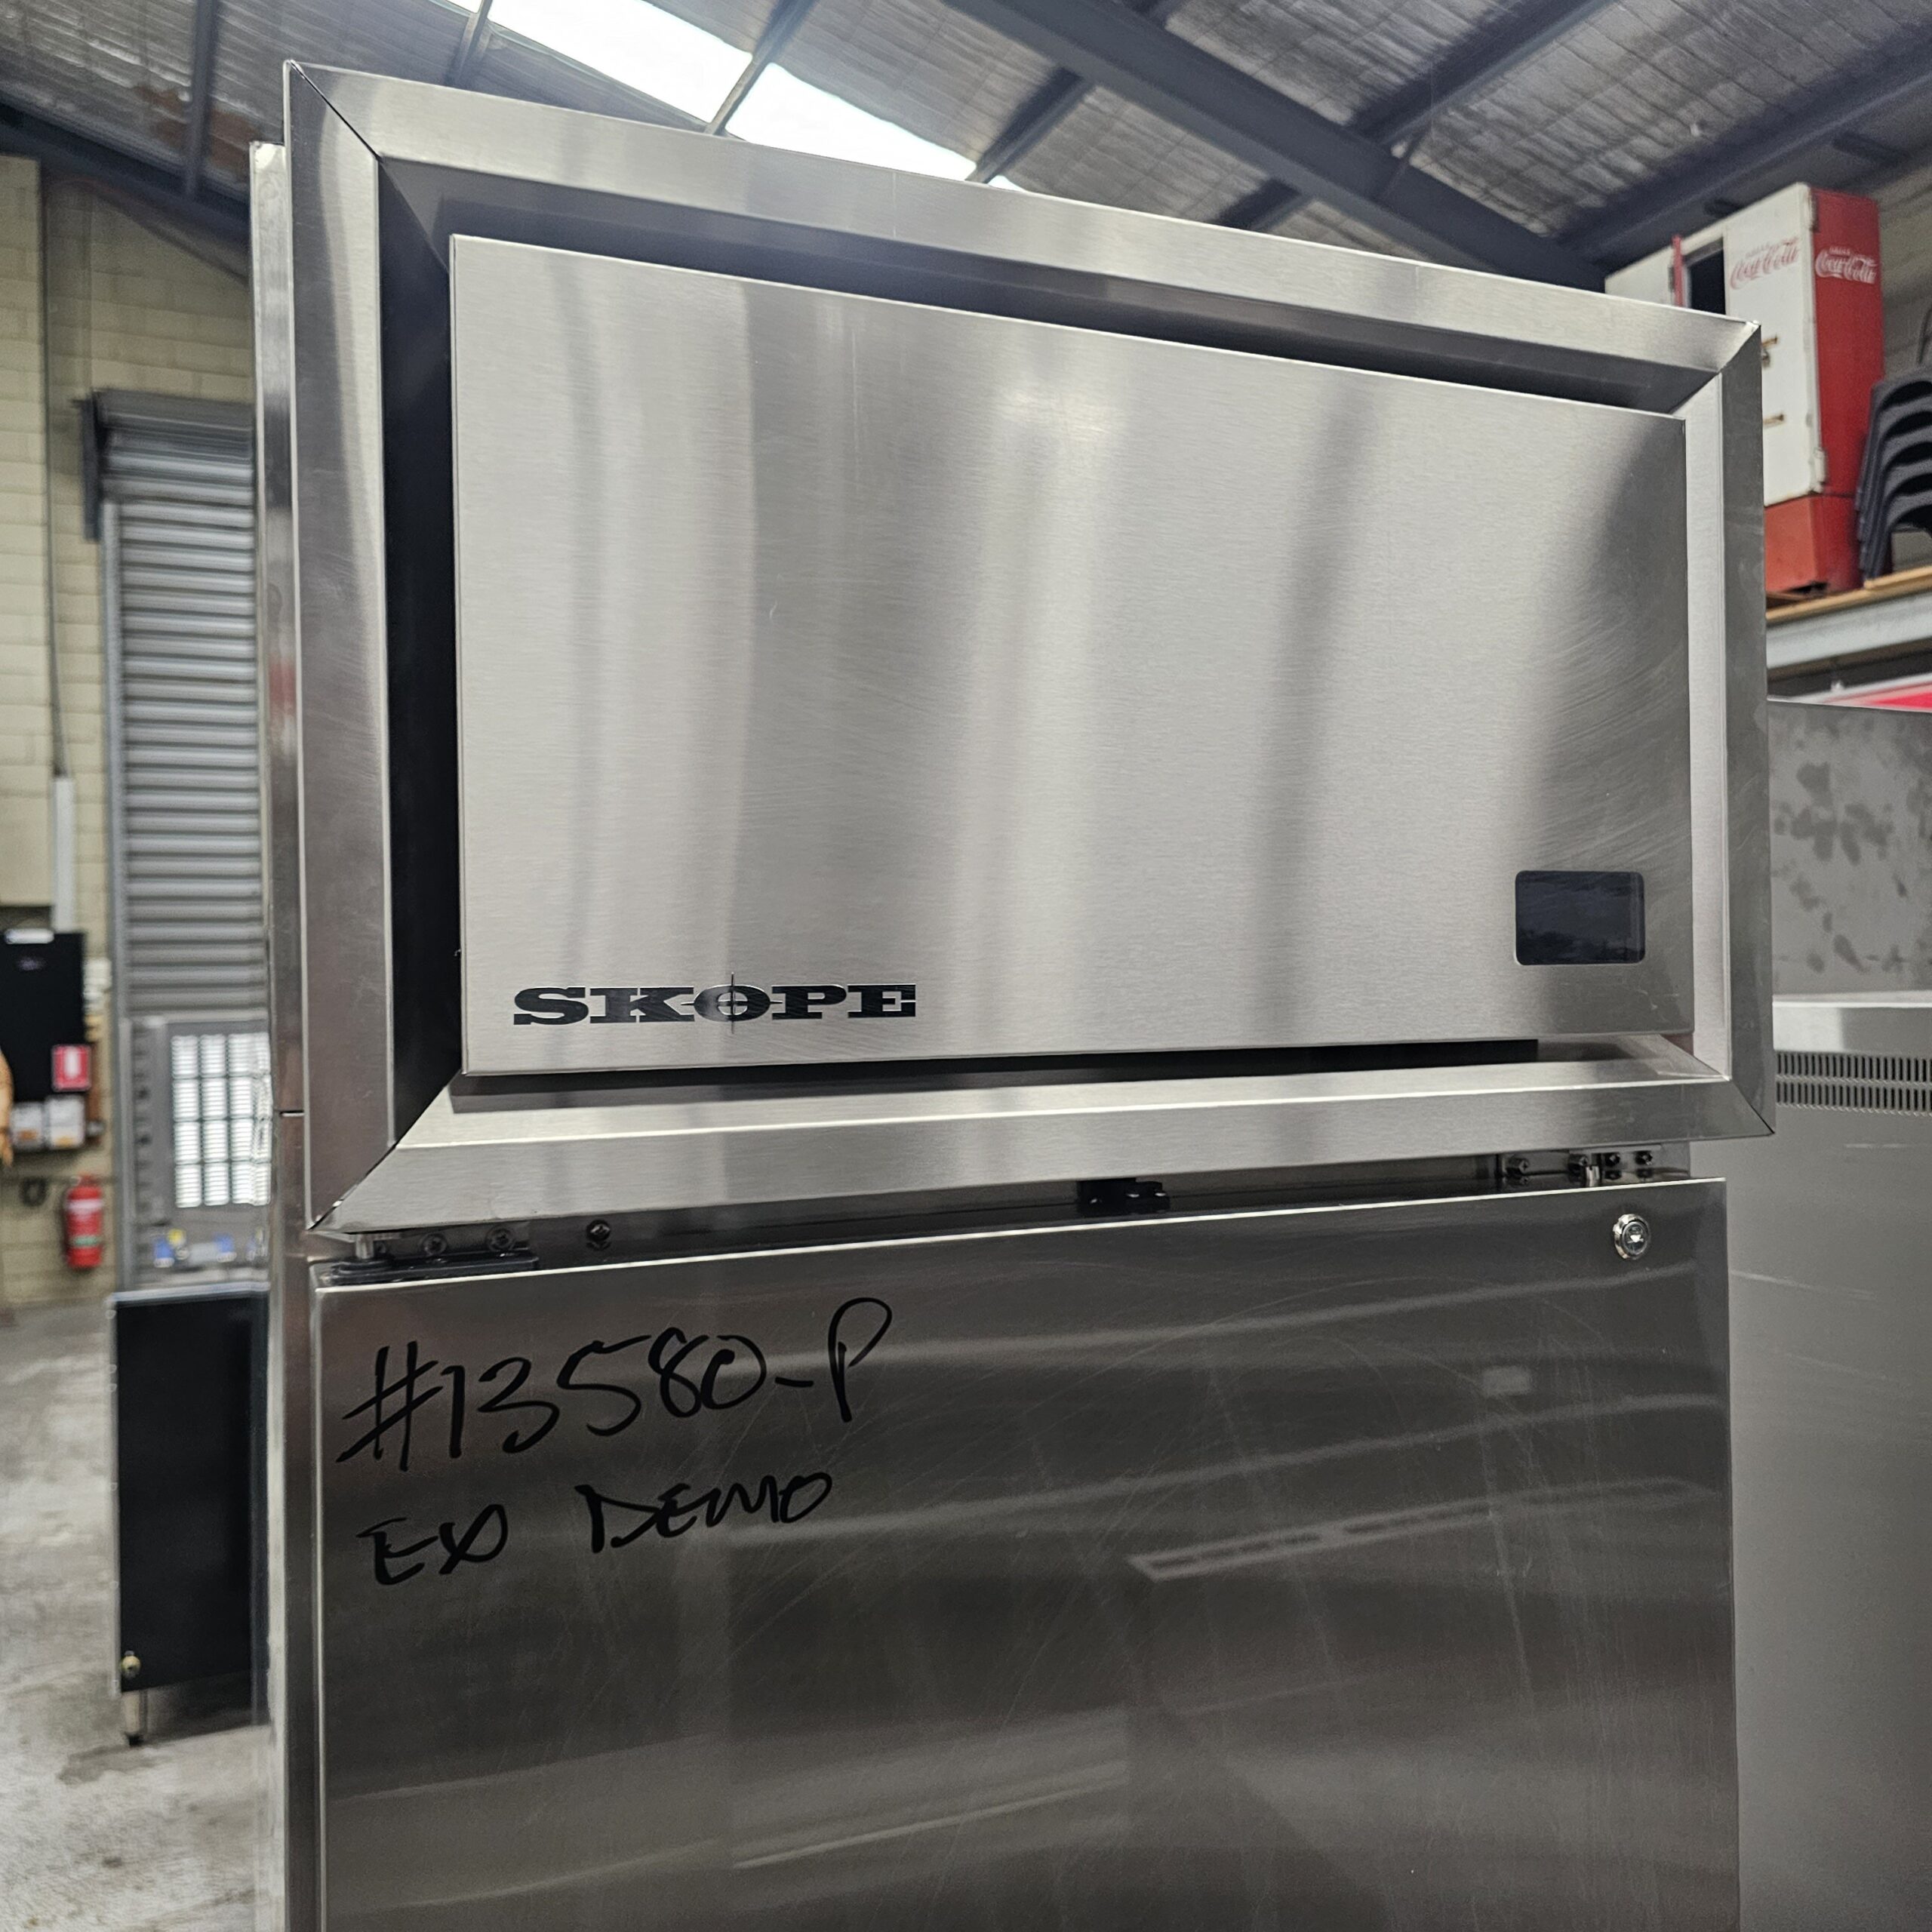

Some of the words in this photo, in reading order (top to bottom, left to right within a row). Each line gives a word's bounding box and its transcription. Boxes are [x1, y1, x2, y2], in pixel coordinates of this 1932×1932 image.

[513, 979, 916, 1028] SKOPE
[335, 1297, 892, 1472] #13580-P
[574, 1472, 832, 1553] DEMO
